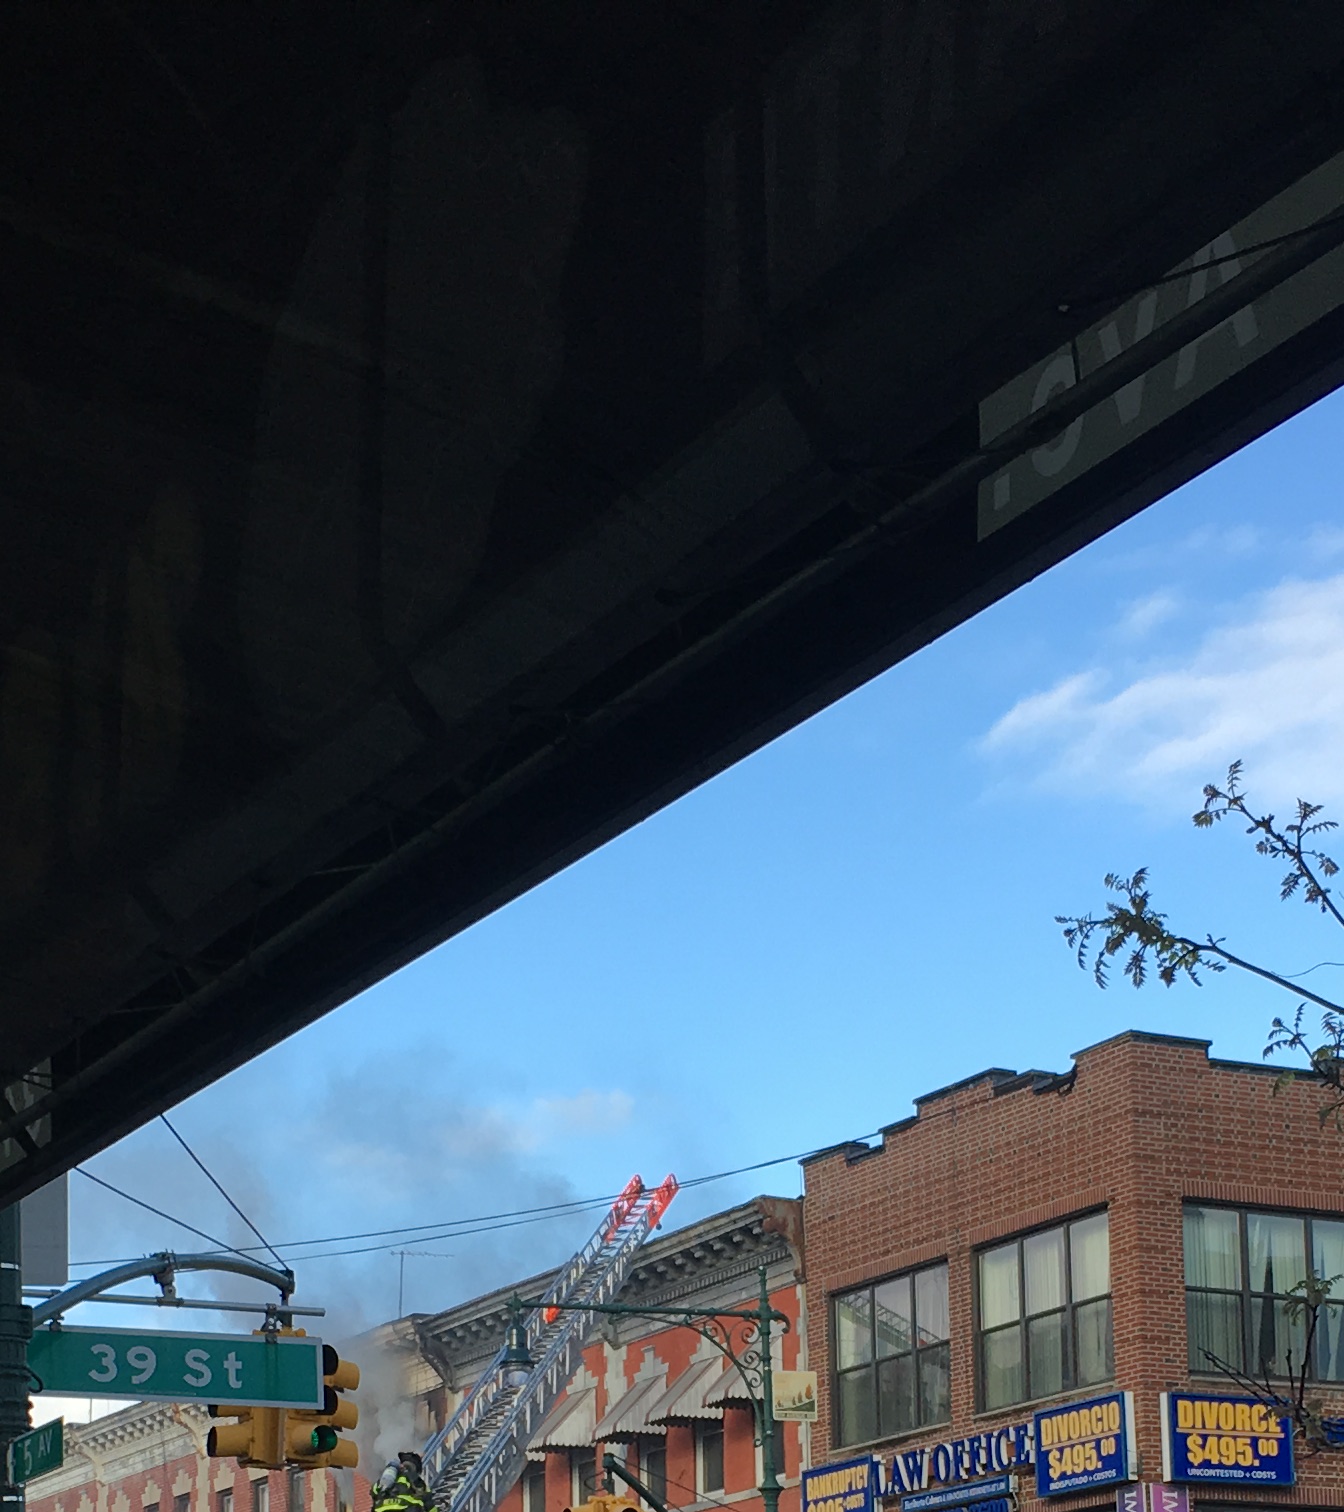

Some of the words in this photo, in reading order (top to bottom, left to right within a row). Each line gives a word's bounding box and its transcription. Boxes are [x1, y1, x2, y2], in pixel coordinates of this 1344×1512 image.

[88, 1343, 157, 1385] 39
[182, 1348, 243, 1390] St
[1040, 1401, 1121, 1446] DIVORCIO
[1176, 1400, 1282, 1433] DIVORCE
[22, 1444, 33, 1477] 5
[37, 1433, 53, 1460] AV
[873, 1448, 931, 1497] LAW
[932, 1422, 1036, 1483] OFFICE
[1186, 1434, 1279, 1467] $495.00
[806, 1463, 869, 1501] BANKRUPTCY
[1187, 1467, 1244, 1479] UNCONTESTED
[1251, 1470, 1277, 1480] COSTS
